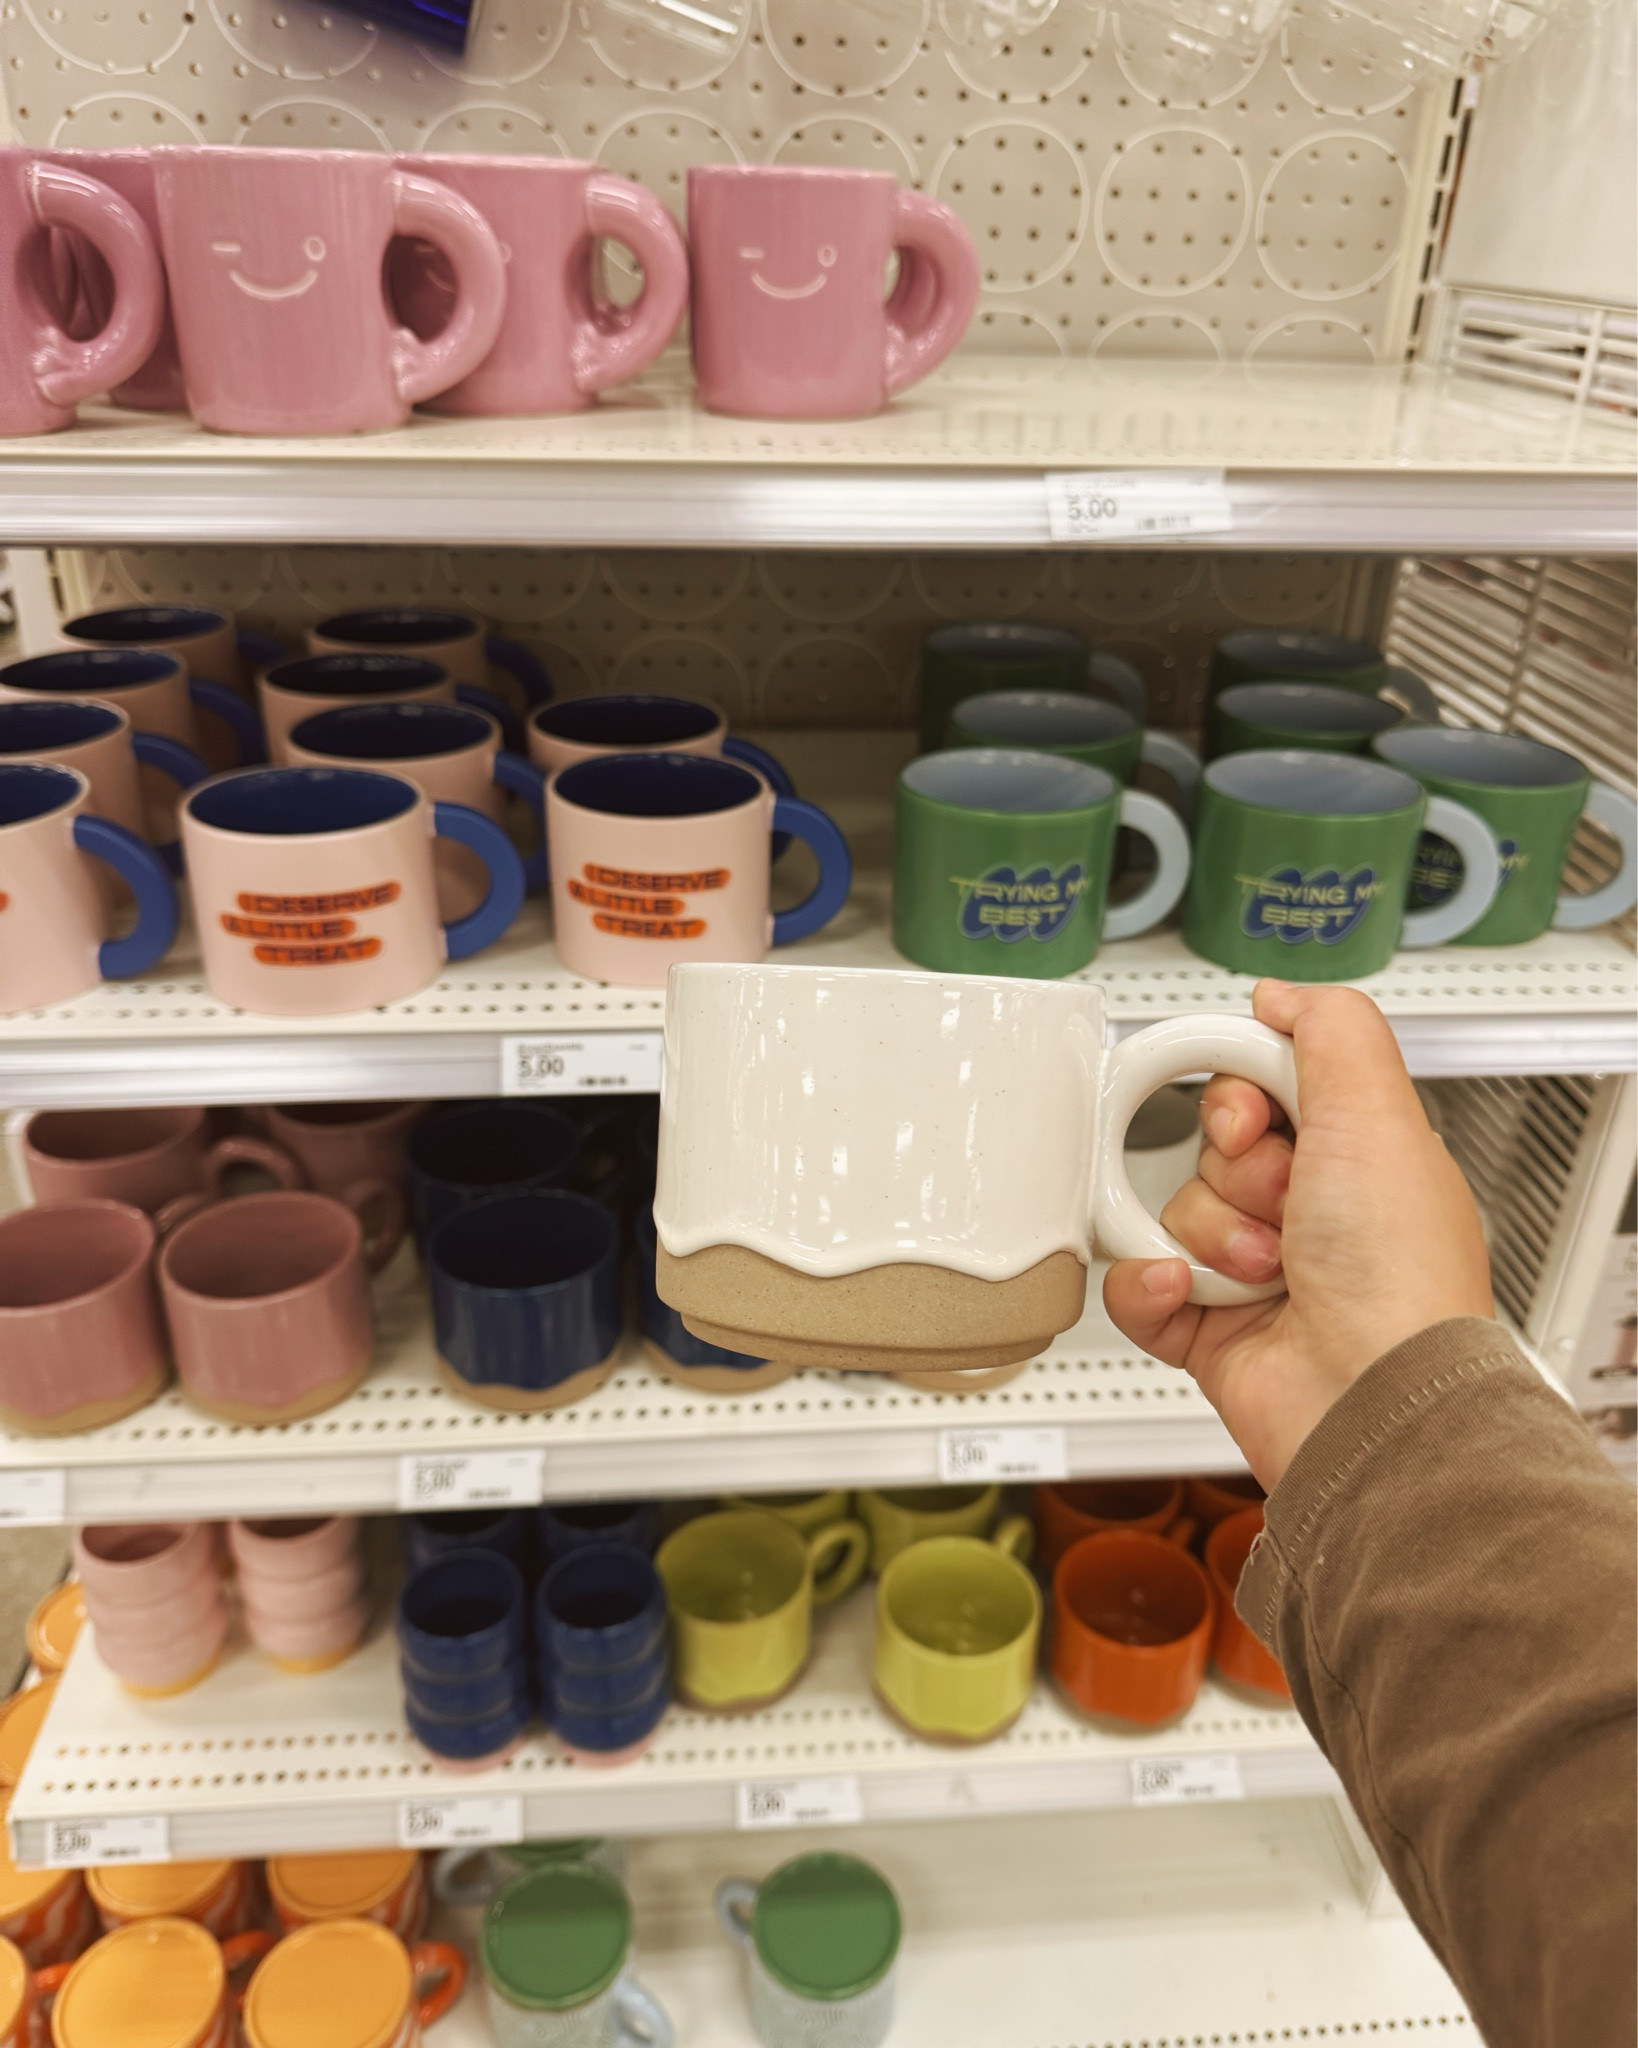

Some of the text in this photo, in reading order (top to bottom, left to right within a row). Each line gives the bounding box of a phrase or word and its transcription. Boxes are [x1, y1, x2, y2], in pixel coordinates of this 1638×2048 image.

[1067, 498, 1117, 521] 5.00
[598, 868, 721, 892] DESERVE
[949, 876, 1092, 903] TRYING MY
[1234, 874, 1387, 905] TRYING MY
[256, 885, 392, 915] DESERVE
[588, 888, 674, 915] LITTLE
[979, 905, 1066, 925] BEST
[1261, 905, 1356, 929] BEST
[248, 919, 344, 939] LITTLE
[602, 916, 697, 938] TREAT
[260, 940, 372, 963] TREAT
[518, 1056, 565, 1078] 5.00
